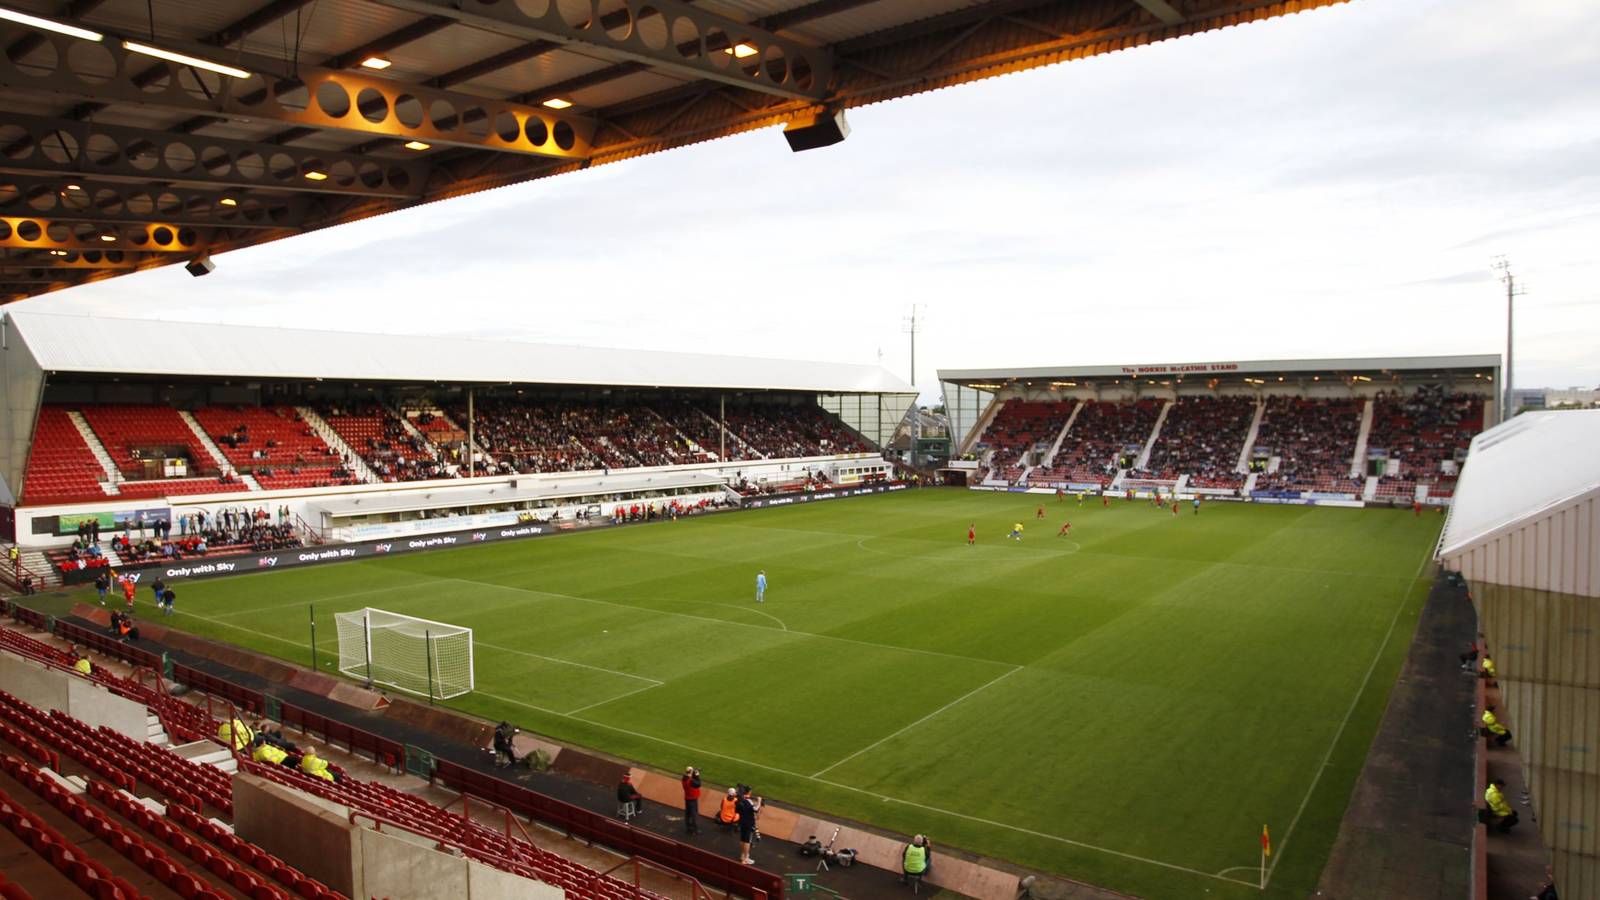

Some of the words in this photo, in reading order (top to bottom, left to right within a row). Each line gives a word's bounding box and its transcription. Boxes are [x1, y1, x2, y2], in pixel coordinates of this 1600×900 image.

[472, 532, 486, 540] sky
[501, 529, 516, 537] Only
[409, 540, 426, 548] Only
[443, 536, 456, 544] Sky
[376, 543, 392, 552] sky
[299, 553, 320, 561] Only
[320, 550, 340, 559] with
[340, 548, 356, 556] Sky
[258, 556, 278, 566] sky
[166, 567, 192, 577] Only
[192, 564, 215, 573] with
[216, 562, 235, 572] Sky
